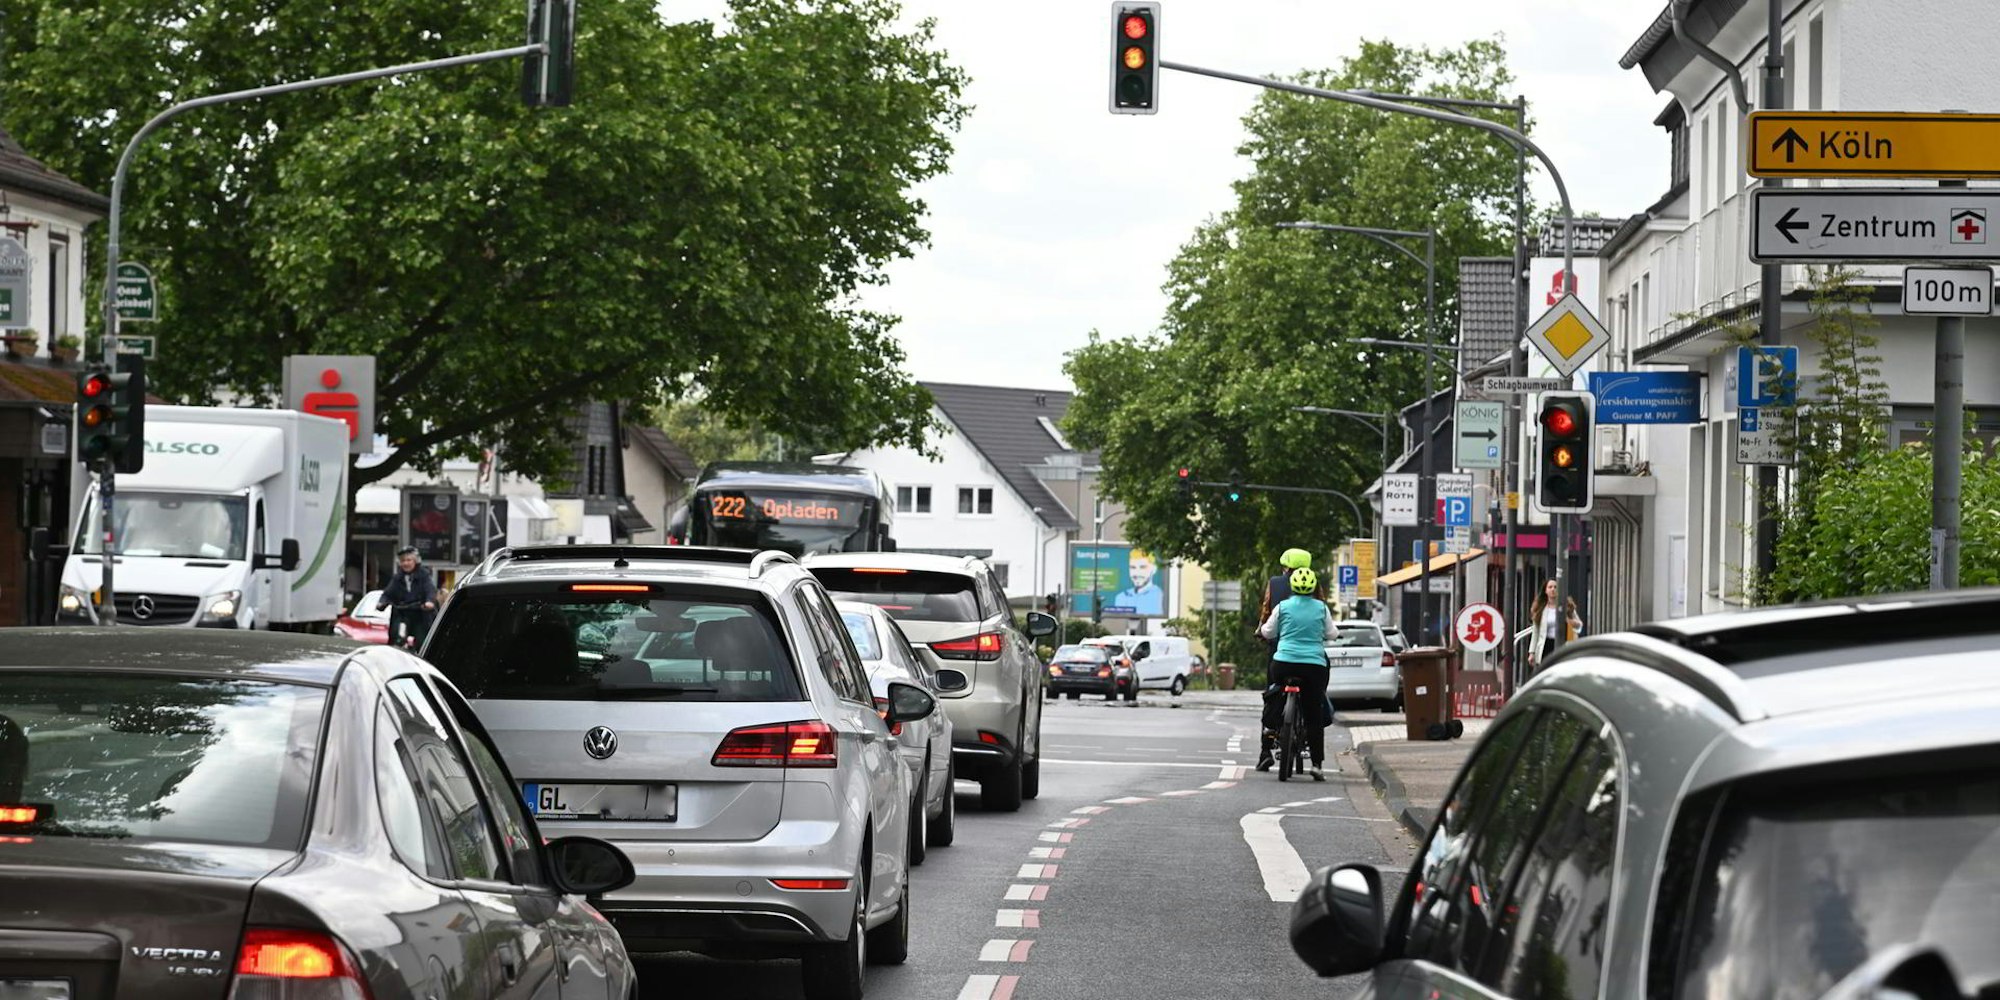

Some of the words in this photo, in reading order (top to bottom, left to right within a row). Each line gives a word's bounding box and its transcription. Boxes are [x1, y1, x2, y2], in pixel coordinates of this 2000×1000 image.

[1820, 131, 1892, 159] Köln
[1821, 214, 1935, 238] Zentrum
[111, 298, 152, 311] heindorf
[1487, 380, 1558, 392] Schlagbaumweg
[1461, 405, 1499, 418] KÖNIG
[1612, 411, 1642, 420] Gunnar
[1644, 411, 1653, 420] M.
[1656, 411, 1678, 420] PAFF
[1740, 450, 1749, 459] Sa
[1387, 479, 1414, 488] PÜTZ
[1386, 491, 1415, 500] ROTH
[712, 496, 746, 518] 222
[763, 498, 839, 520] Opladen
[539, 787, 567, 810] GL
[132, 946, 221, 960] VECTRA
